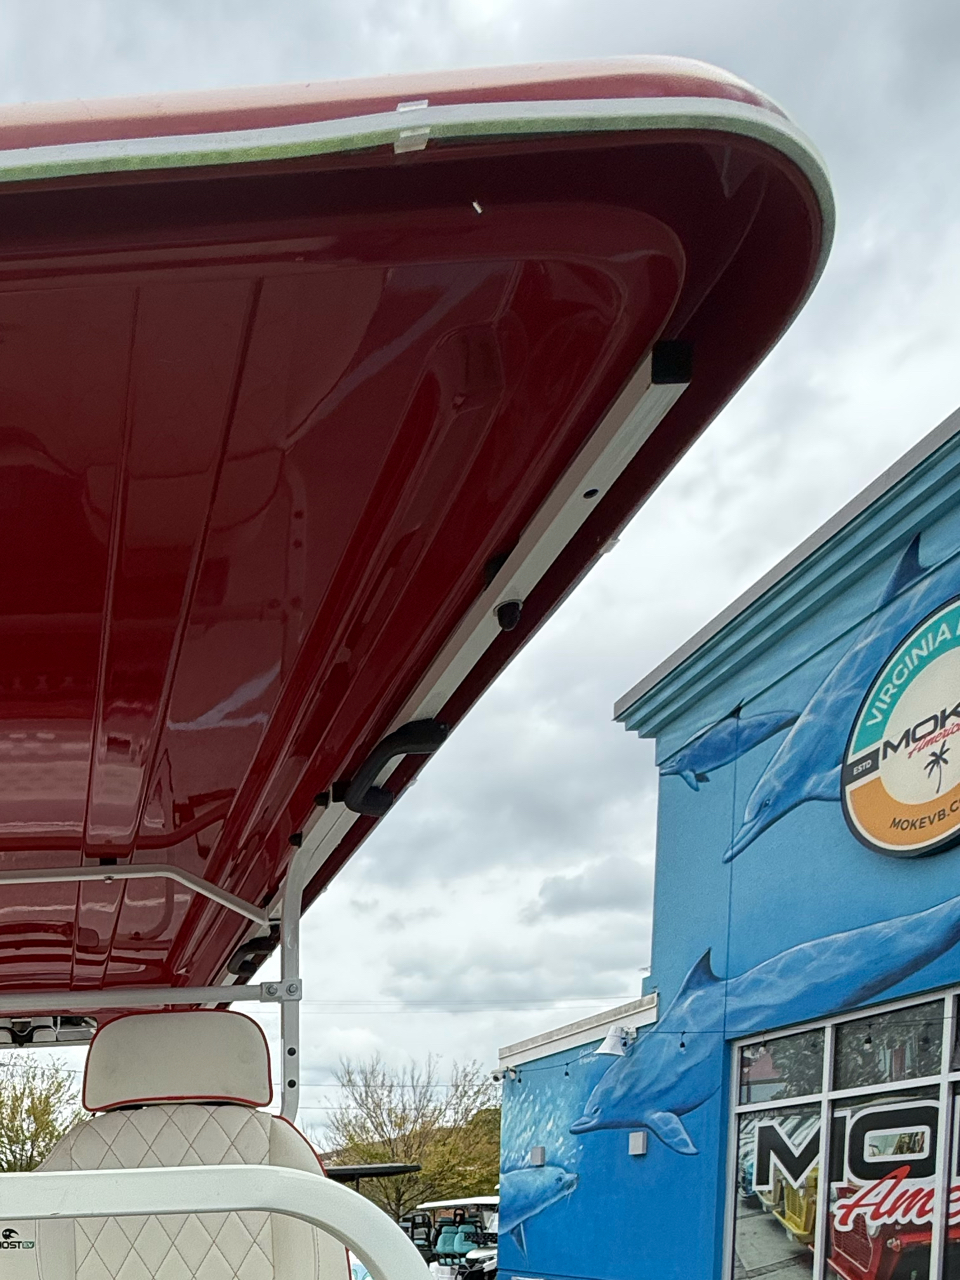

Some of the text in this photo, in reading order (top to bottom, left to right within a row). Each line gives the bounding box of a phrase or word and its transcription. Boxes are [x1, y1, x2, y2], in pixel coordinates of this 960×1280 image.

[866, 623, 952, 727] VIRGINIA
[853, 760, 872, 776] ESTD
[890, 800, 960, 831] MOKEVB.C
[754, 1104, 960, 1187] MO
